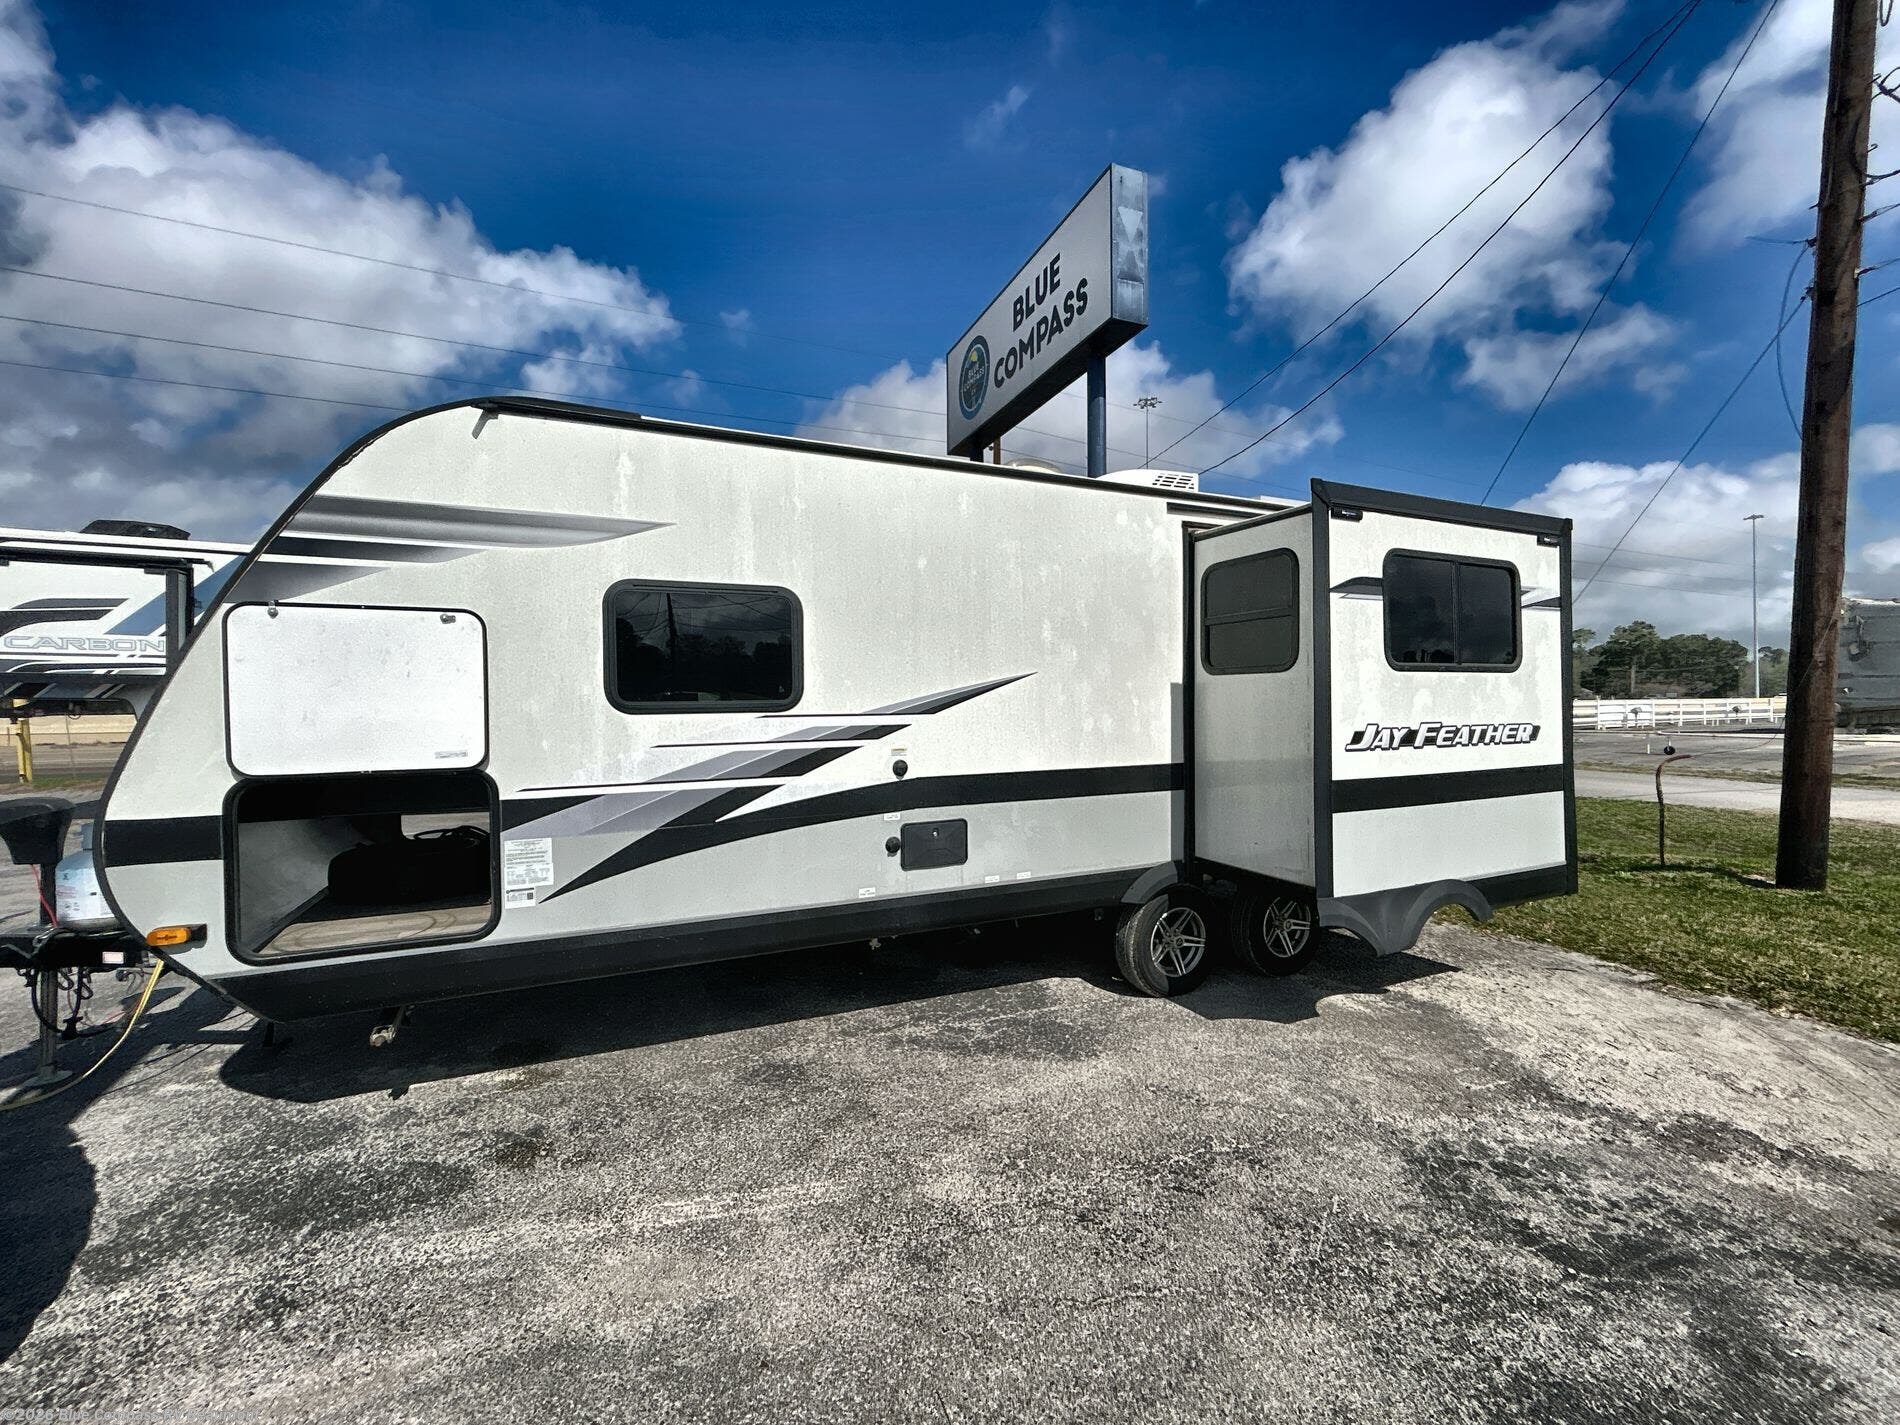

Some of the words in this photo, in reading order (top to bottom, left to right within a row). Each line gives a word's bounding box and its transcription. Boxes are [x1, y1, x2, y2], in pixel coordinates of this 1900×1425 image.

[1012, 252, 1061, 333] BLUE
[993, 277, 1088, 389] COMPASS
[3, 635, 165, 653] CARBON
[1344, 723, 1411, 752] JAY
[1412, 721, 1535, 749] FEATHER
